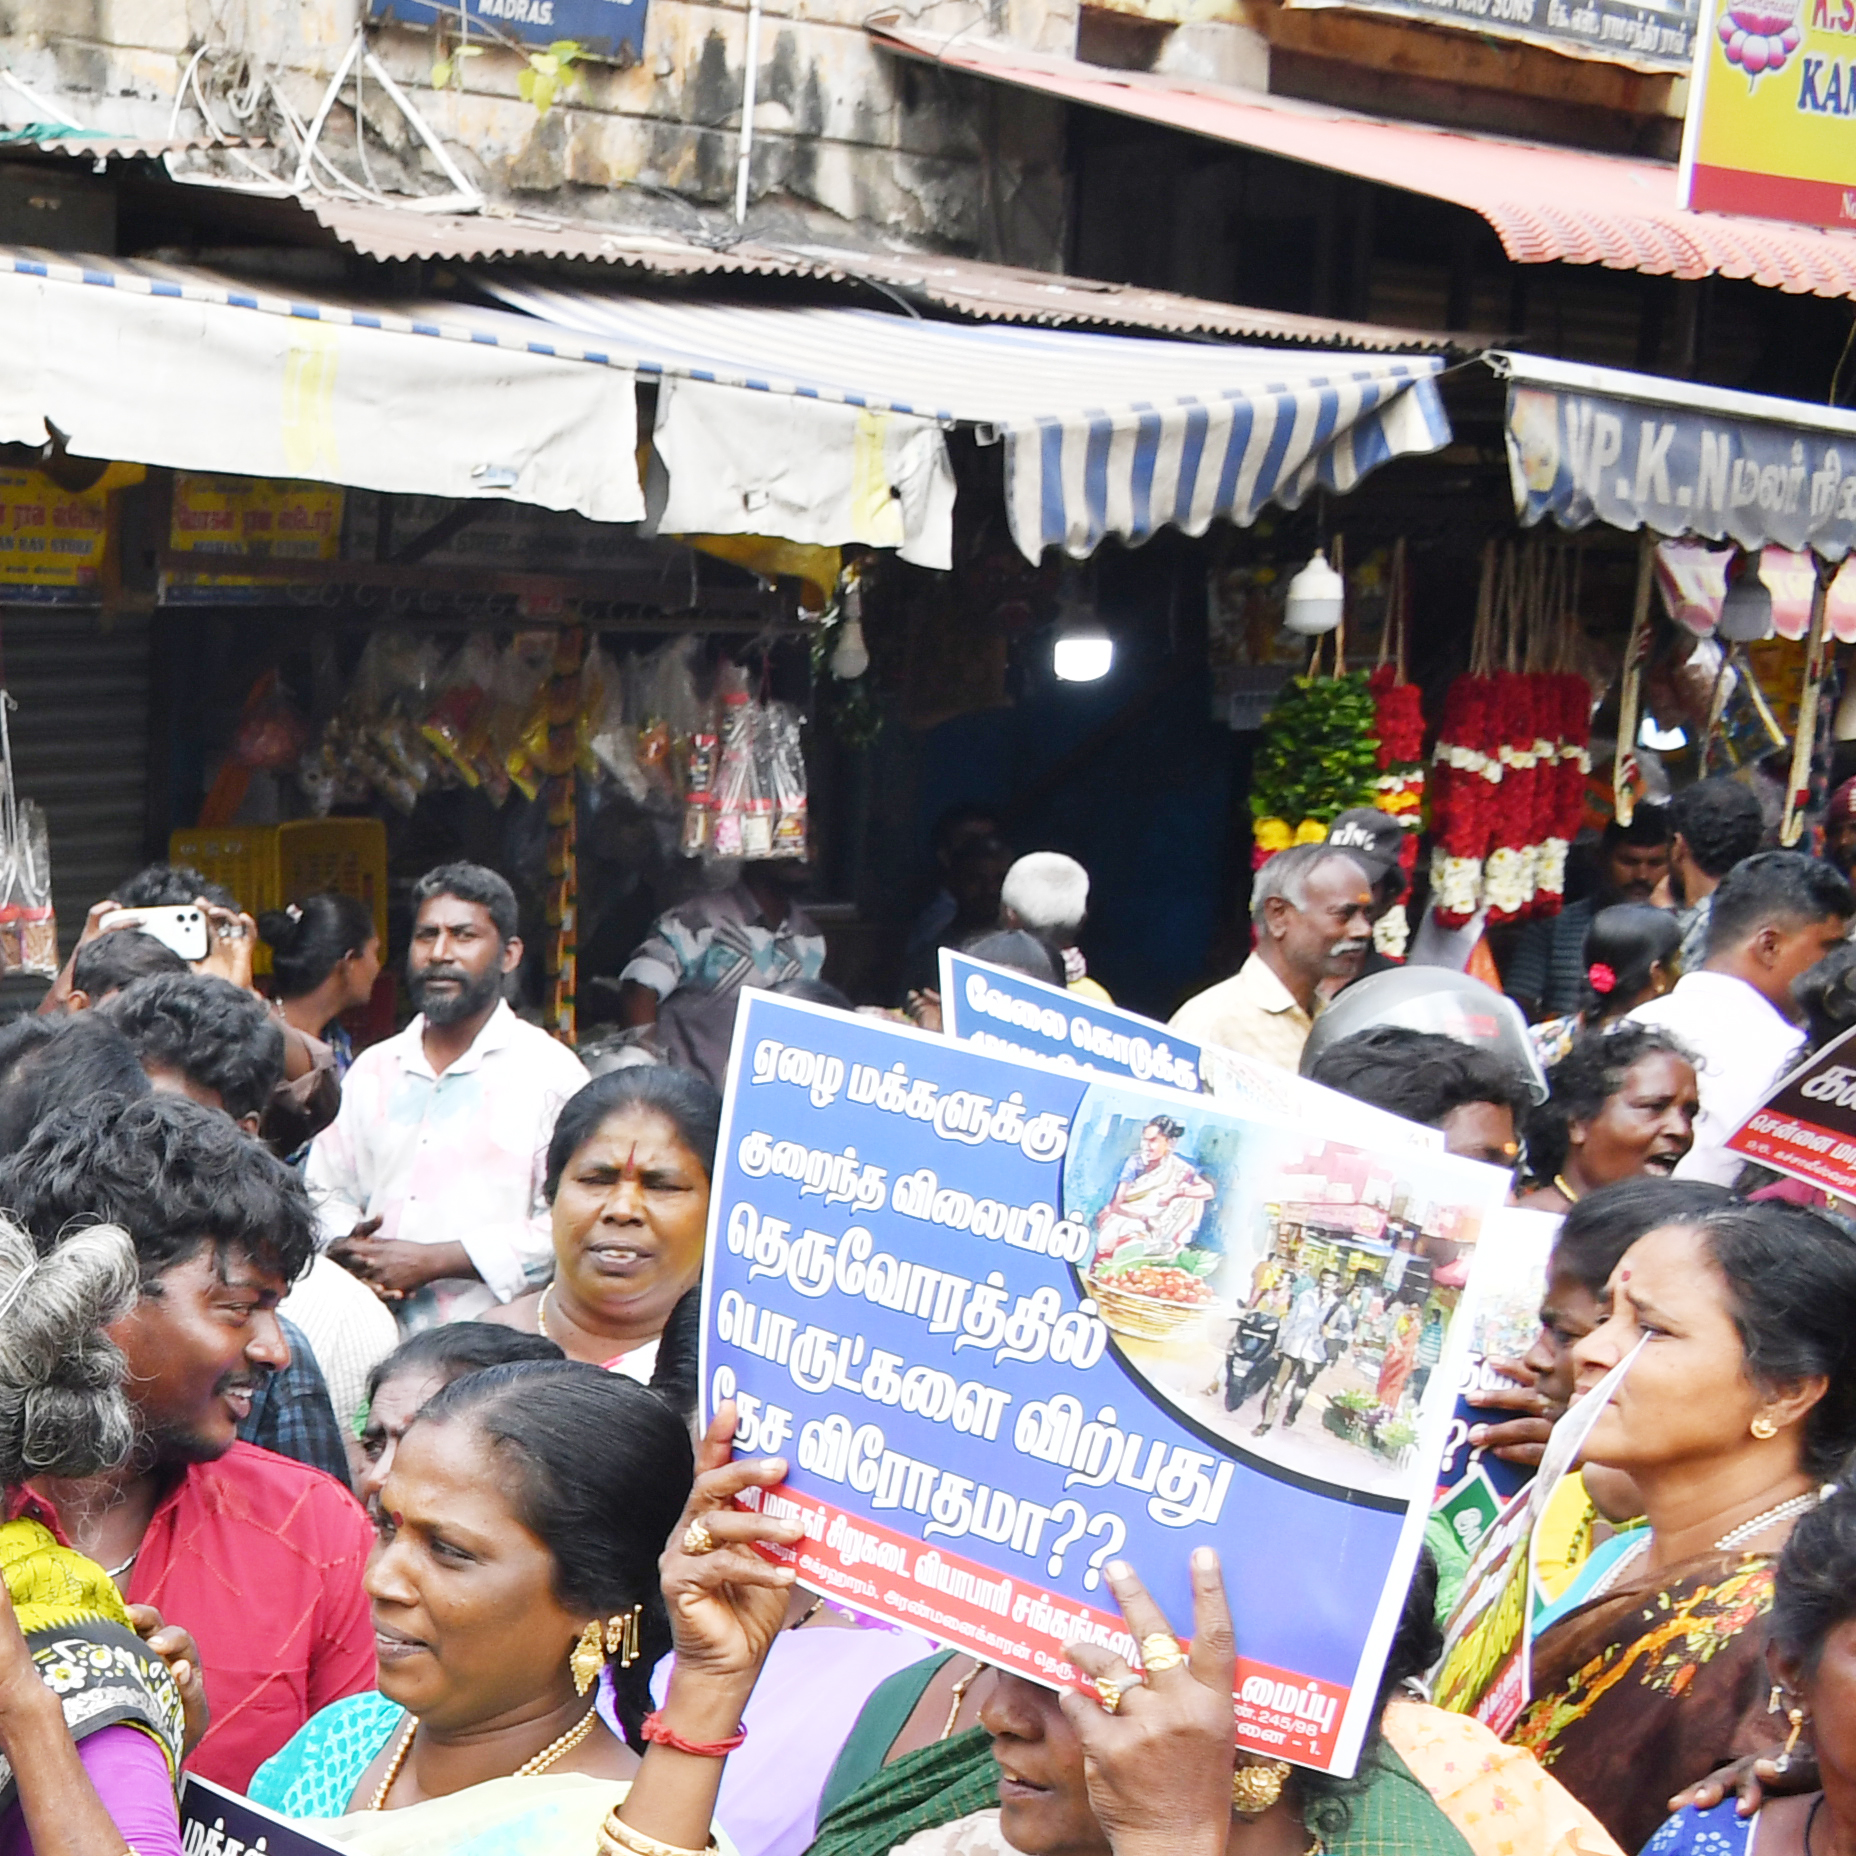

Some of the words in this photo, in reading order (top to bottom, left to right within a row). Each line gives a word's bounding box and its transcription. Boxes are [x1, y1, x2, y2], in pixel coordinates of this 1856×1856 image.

[749, 1036, 845, 1112] ஏழை
[845, 1060, 1071, 1164] மக்களுக்கு
[965, 973, 1068, 1041] வேலை
[1070, 1016, 1199, 1092] கொடுக்க
[734, 1124, 890, 1207] குறைந்த
[889, 1166, 1091, 1267] விலையில்
[724, 1200, 1111, 1374] தெருவோரத்தில்
[715, 1288, 1013, 1445] பொருட்களை
[1011, 1388, 1239, 1529] விற்பது
[795, 1417, 1129, 1596] விரோதமா??
[825, 1512, 914, 1581] சிறுகடை
[913, 1554, 1013, 1618] வியாபாரி
